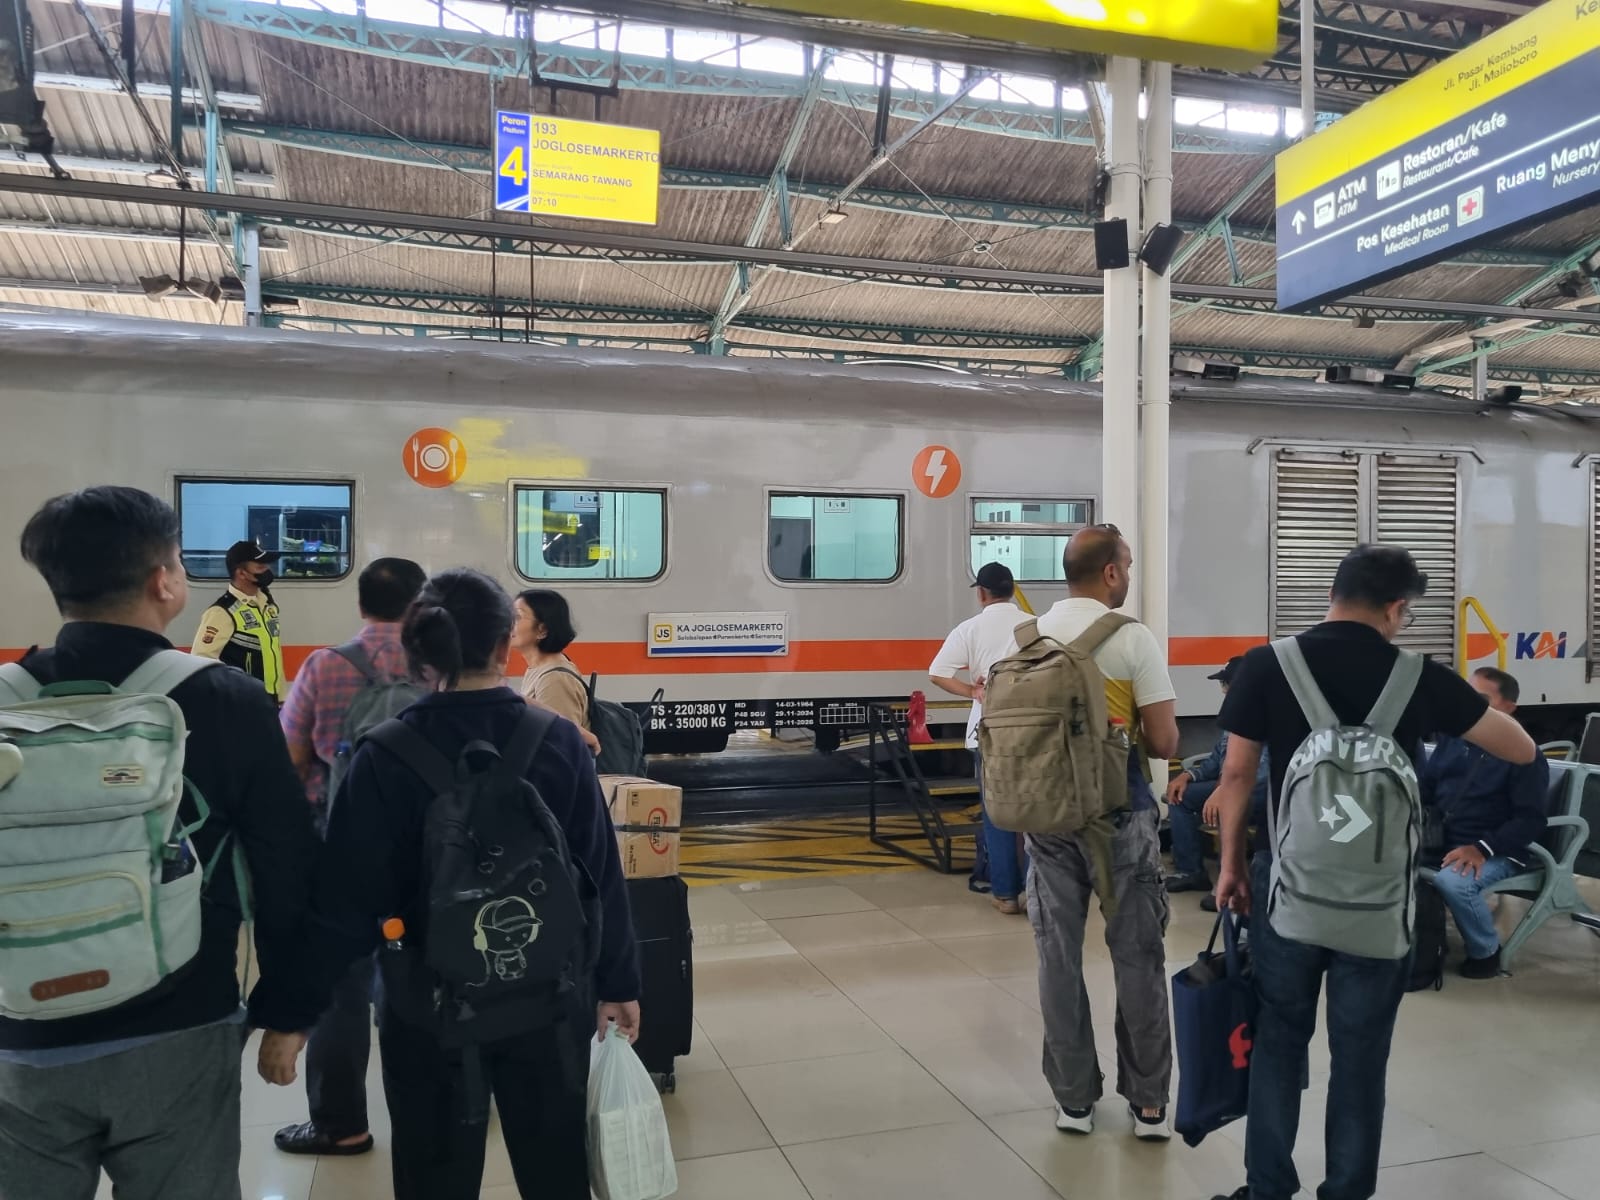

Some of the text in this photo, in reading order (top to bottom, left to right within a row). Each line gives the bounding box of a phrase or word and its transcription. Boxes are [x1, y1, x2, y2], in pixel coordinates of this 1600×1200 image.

[1576, 0, 1600, 21] Ke
[1458, 64, 1485, 84] Pasar
[1487, 35, 1538, 67] Kembang
[1484, 50, 1538, 83] Malioboro
[501, 114, 527, 126] Peron
[534, 122, 557, 135] 193
[533, 139, 659, 163] JOGLOSEMARKERTO
[1403, 112, 1507, 173] Restoran/Kafe
[499, 146, 527, 186] 4
[532, 169, 633, 188] SEMARANG TAWANG
[1403, 145, 1480, 189] Restaurant/Cafe
[1496, 161, 1546, 194] Ruang
[1552, 160, 1600, 188] Nursery
[532, 196, 557, 207] 07:10
[1337, 176, 1367, 204] ATM
[1337, 199, 1358, 218] ATM
[1357, 203, 1450, 253] Pos Kesehatan
[1384, 222, 1449, 257] Medical Room
[657, 629, 670, 638] JS
[677, 623, 783, 632] KA JOGLOSEMARKERTO
[1515, 631, 1568, 660] KAI
[650, 705, 665, 716] TS
[674, 704, 716, 715] 220/380
[718, 703, 727, 714] V
[650, 718, 666, 729] BK
[676, 718, 708, 729] 35000
[711, 716, 727, 728] KG
